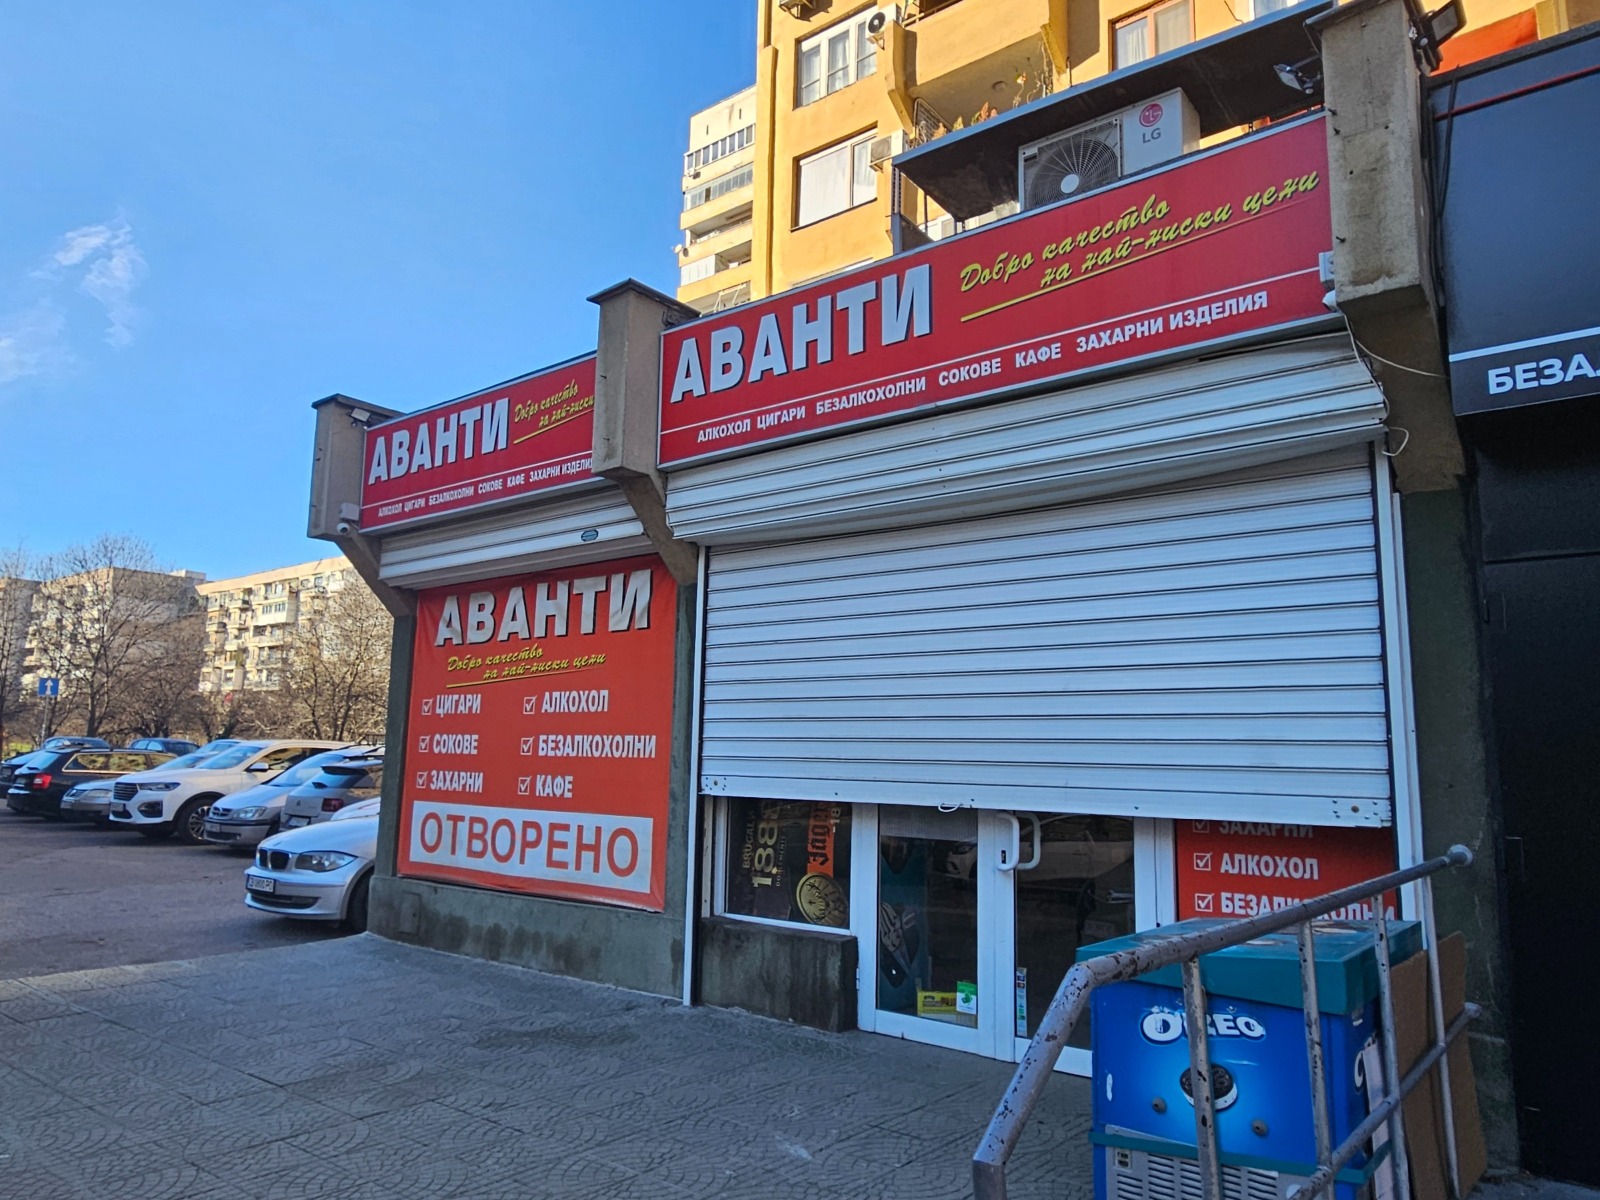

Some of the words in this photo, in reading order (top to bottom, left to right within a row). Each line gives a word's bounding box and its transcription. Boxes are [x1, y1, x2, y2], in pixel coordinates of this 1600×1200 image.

[1142, 127, 1162, 144] LG
[960, 252, 1034, 292] Добро
[1042, 195, 1170, 261] качество
[1040, 264, 1072, 288] на
[1082, 202, 1232, 275] най-ниски
[1242, 171, 1319, 216] цени
[670, 263, 931, 404] АВАНТИ
[697, 419, 750, 443] АЛКОХОЛ
[756, 405, 806, 430] ЦИГАРИ
[816, 376, 926, 416] БЕЗАЛКОХОЛНИ
[938, 357, 1001, 387] СОКОВЕ
[1015, 343, 1062, 368] КАФЕ
[1076, 317, 1164, 353] ЗАХАРНИ
[1170, 290, 1269, 330] ИЗДЕЛИЯ
[1487, 353, 1600, 395] БЕЗА
[514, 401, 538, 422] Добро
[368, 397, 510, 485] АВАНТИ
[378, 503, 403, 517] АЛКОХОЛ
[404, 498, 426, 513] ЦИГАРИ
[429, 486, 474, 506] БЕЗАЛКОХОЛНИ
[478, 478, 503, 494] СОКОВЕ
[507, 473, 525, 488] КАФЕ
[529, 464, 561, 483] ЗАХАРНИ
[434, 569, 651, 647] АВАНТИ
[447, 652, 482, 672] Добро
[485, 643, 544, 666] качество
[483, 666, 498, 680] на
[502, 658, 569, 678] най-ниски
[573, 653, 607, 670] цени
[435, 694, 481, 718] ЦИГАРИ
[541, 690, 609, 713] АЛКОХОЛ
[432, 734, 479, 755] СОКОВЕ
[538, 735, 656, 758] БЕЗАЛКОХОЛНИ
[429, 770, 484, 793] ЗАХАРНИ
[535, 774, 573, 798] КАФЕ
[420, 811, 639, 878] ОТВОРЕНО
[1220, 853, 1319, 880] АЛКОХОЛ
